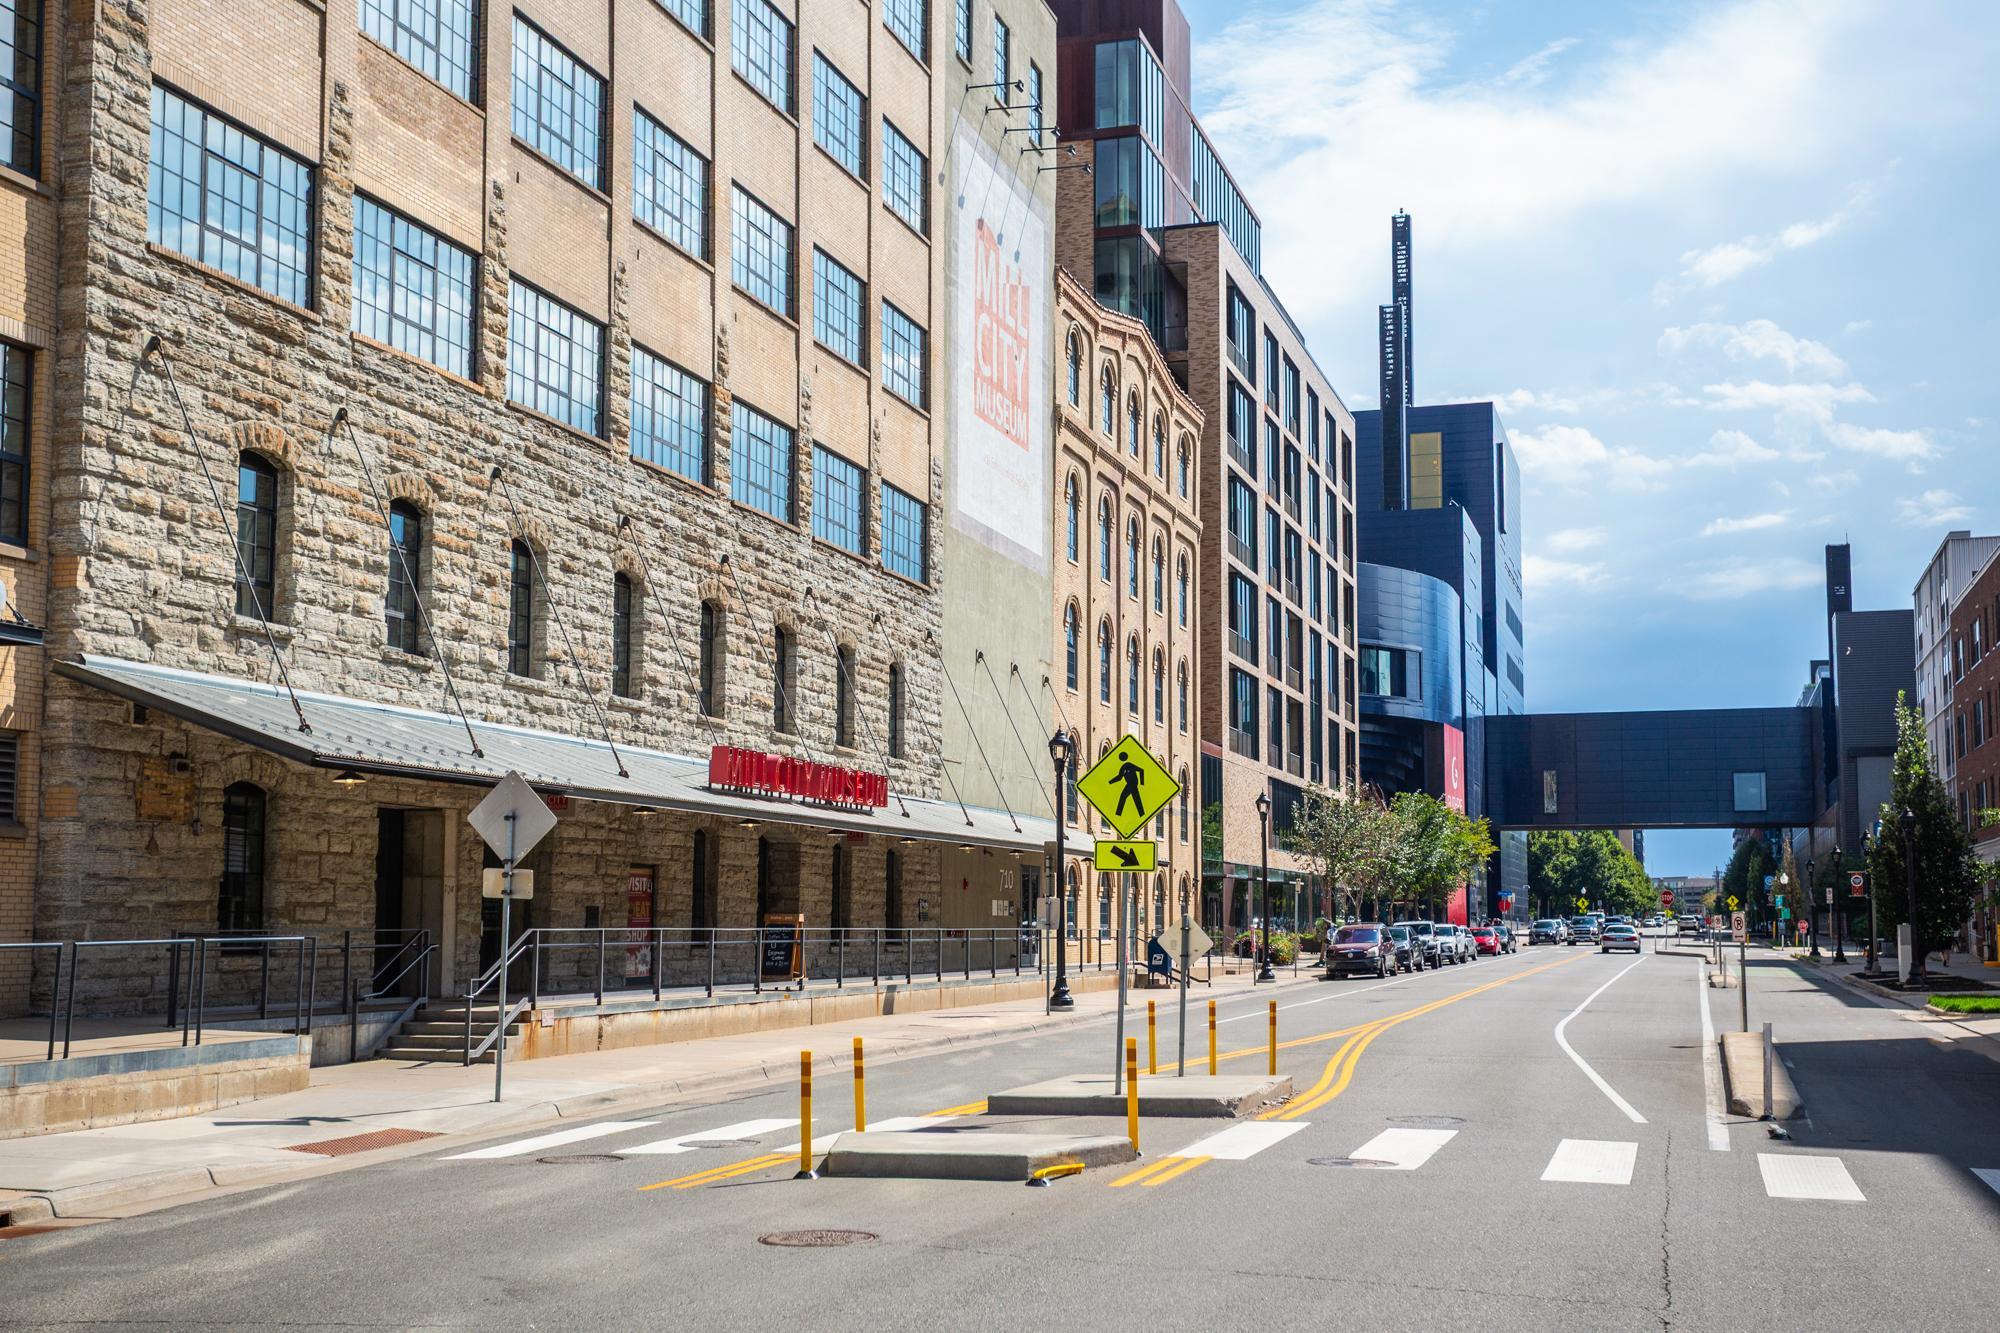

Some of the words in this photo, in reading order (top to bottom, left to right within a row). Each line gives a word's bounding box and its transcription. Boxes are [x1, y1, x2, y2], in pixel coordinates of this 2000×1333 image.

[976, 239, 1028, 337] MILL
[976, 313, 1027, 402] CITY
[975, 377, 1028, 444] MUSEUM
[714, 746, 770, 788] MILL
[772, 755, 815, 796] CITY
[817, 764, 888, 807] MUSEUM
[635, 902, 650, 918] EAT
[999, 869, 1014, 892] 710
[626, 929, 648, 942] SHOP
